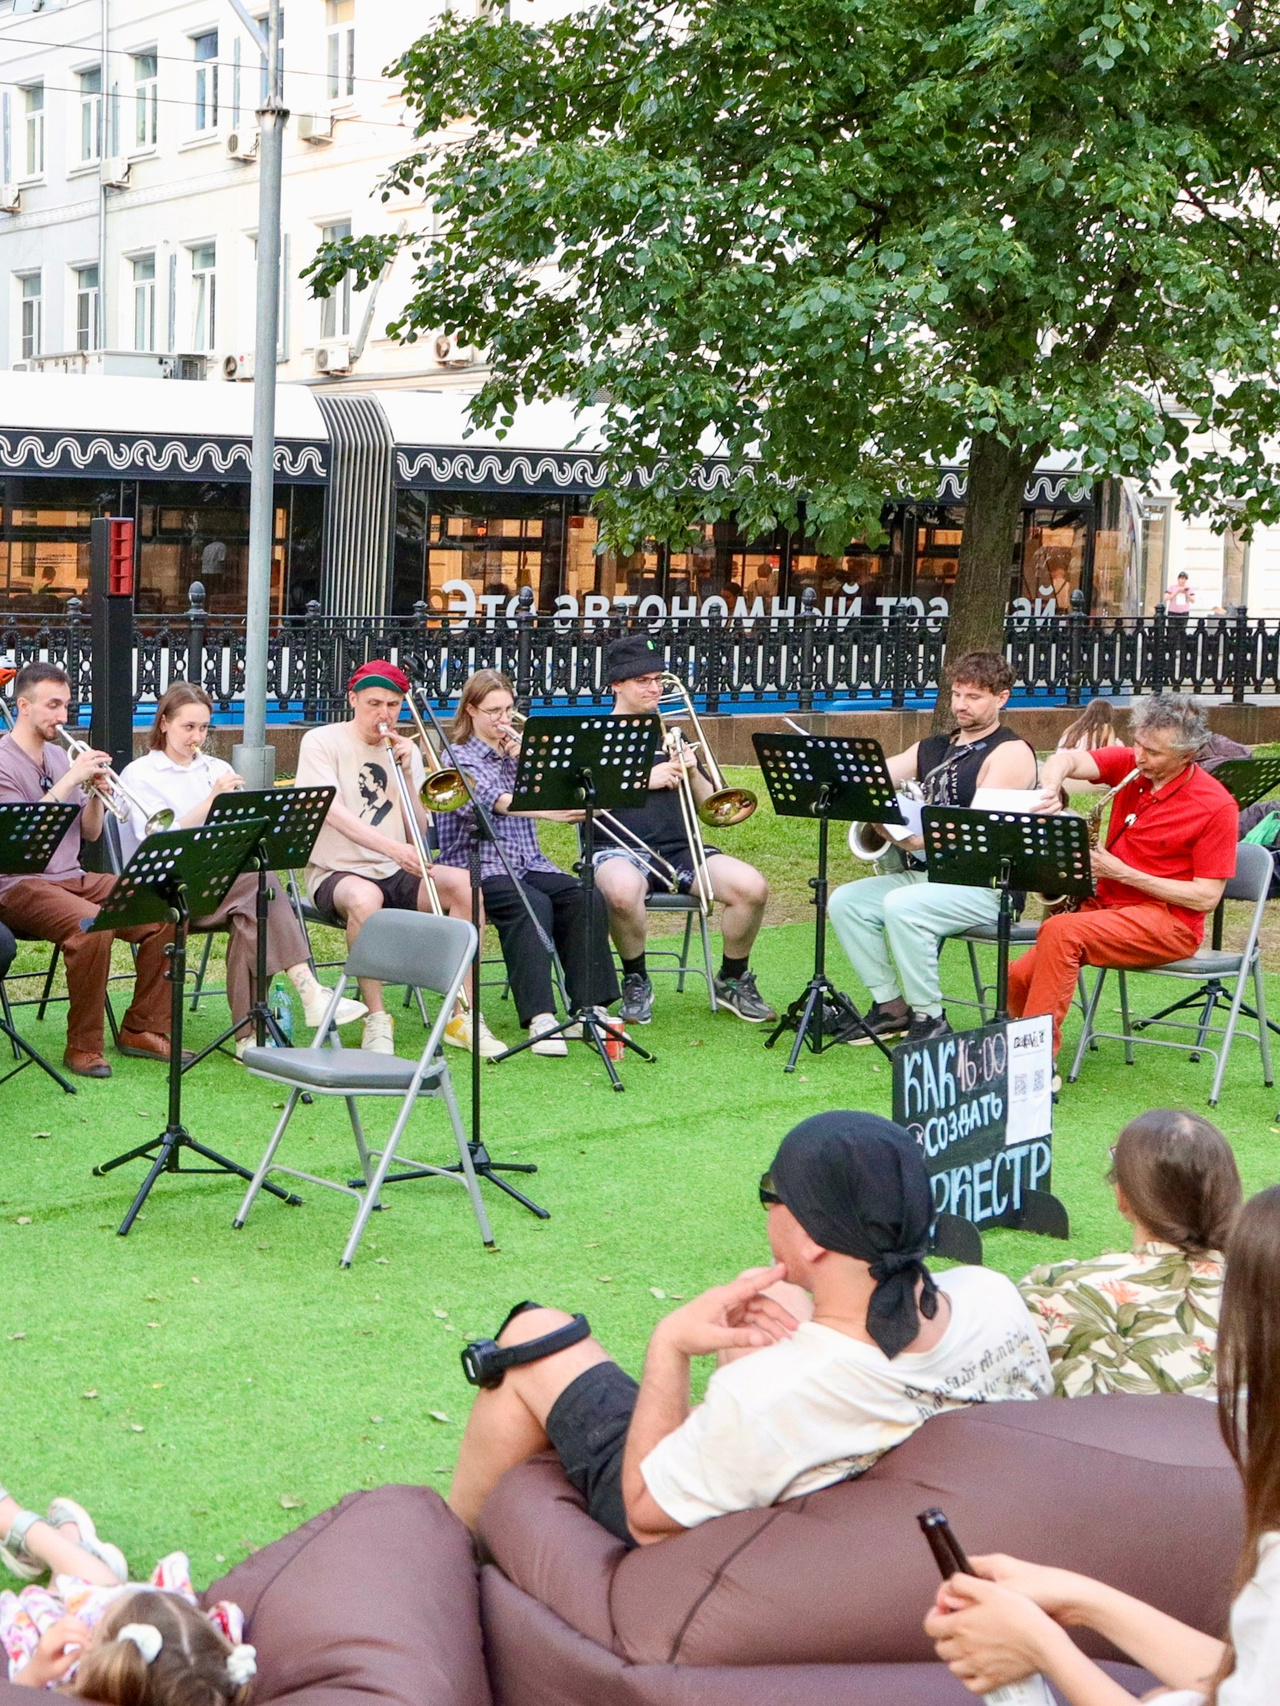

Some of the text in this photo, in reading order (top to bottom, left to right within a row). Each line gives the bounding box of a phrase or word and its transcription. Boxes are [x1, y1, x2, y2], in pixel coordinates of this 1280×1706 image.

[904, 1032, 1007, 1119] КАК 16:00
[924, 1092, 1003, 1158] СОЗДАТЬ
[929, 1141, 1052, 1226] РКЕСТР
